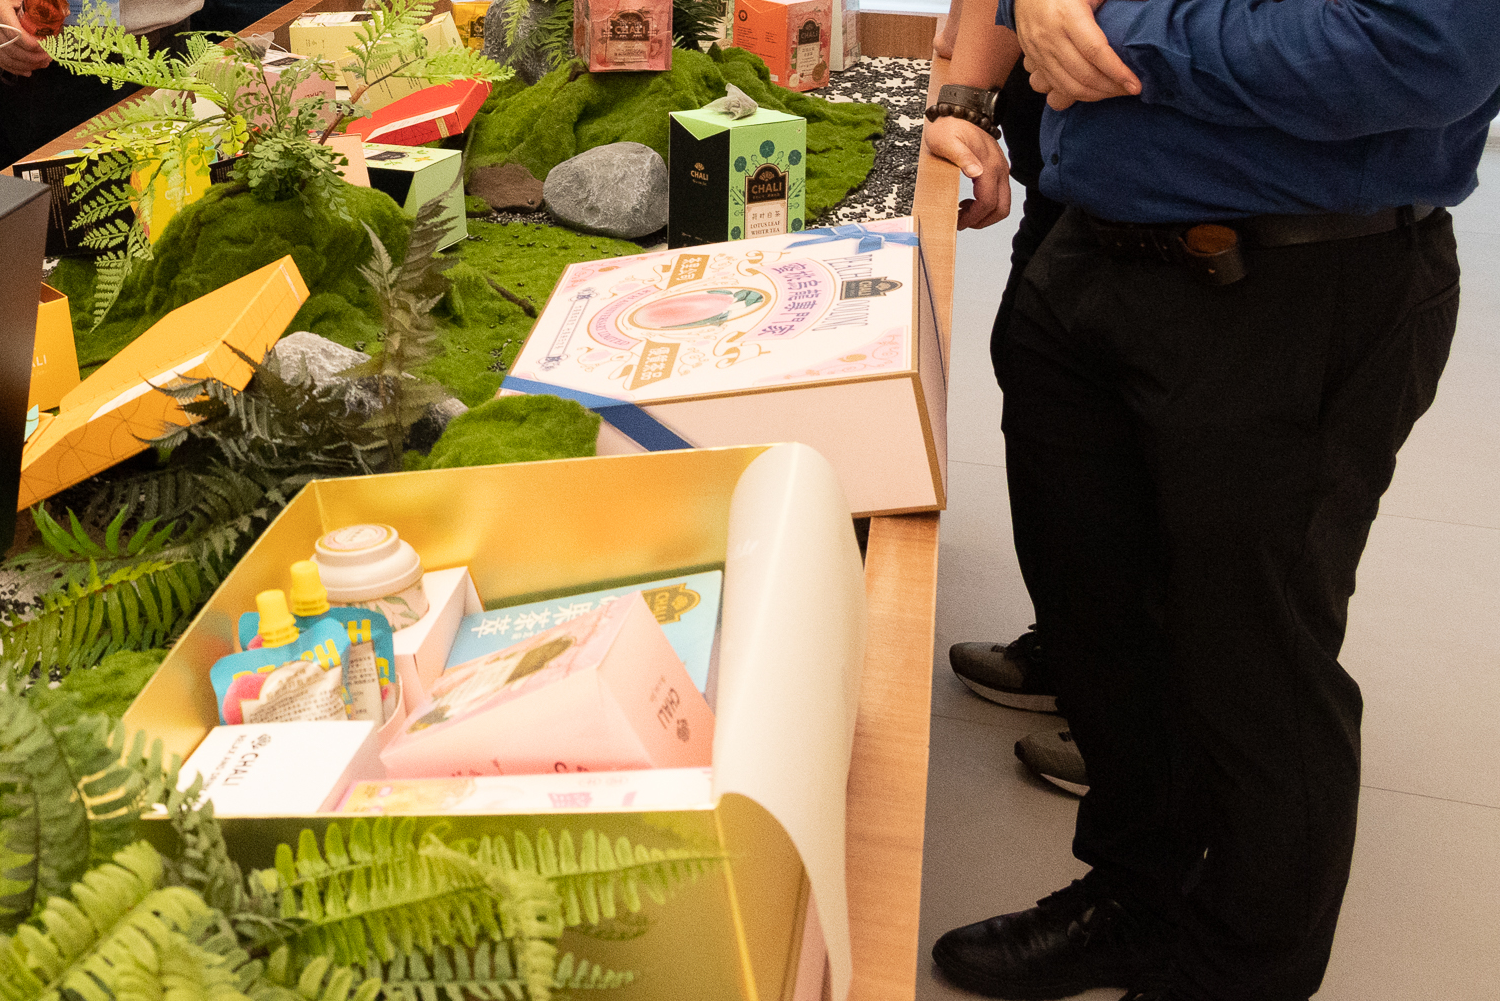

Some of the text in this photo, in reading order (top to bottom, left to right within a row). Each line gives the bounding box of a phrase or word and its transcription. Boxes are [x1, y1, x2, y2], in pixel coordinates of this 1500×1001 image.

[615, 25, 647, 35] CHALI
[690, 170, 709, 181] CHALI
[751, 182, 782, 195] CHALI
[758, 263, 822, 336] 蜜桃烏龍專門家
[811, 254, 873, 331] PEACH OOLONG
[858, 280, 873, 297] CHALI
[640, 346, 671, 381] 優質茶品
[657, 687, 681, 731] CHALI
[222, 752, 259, 787] CHALI
